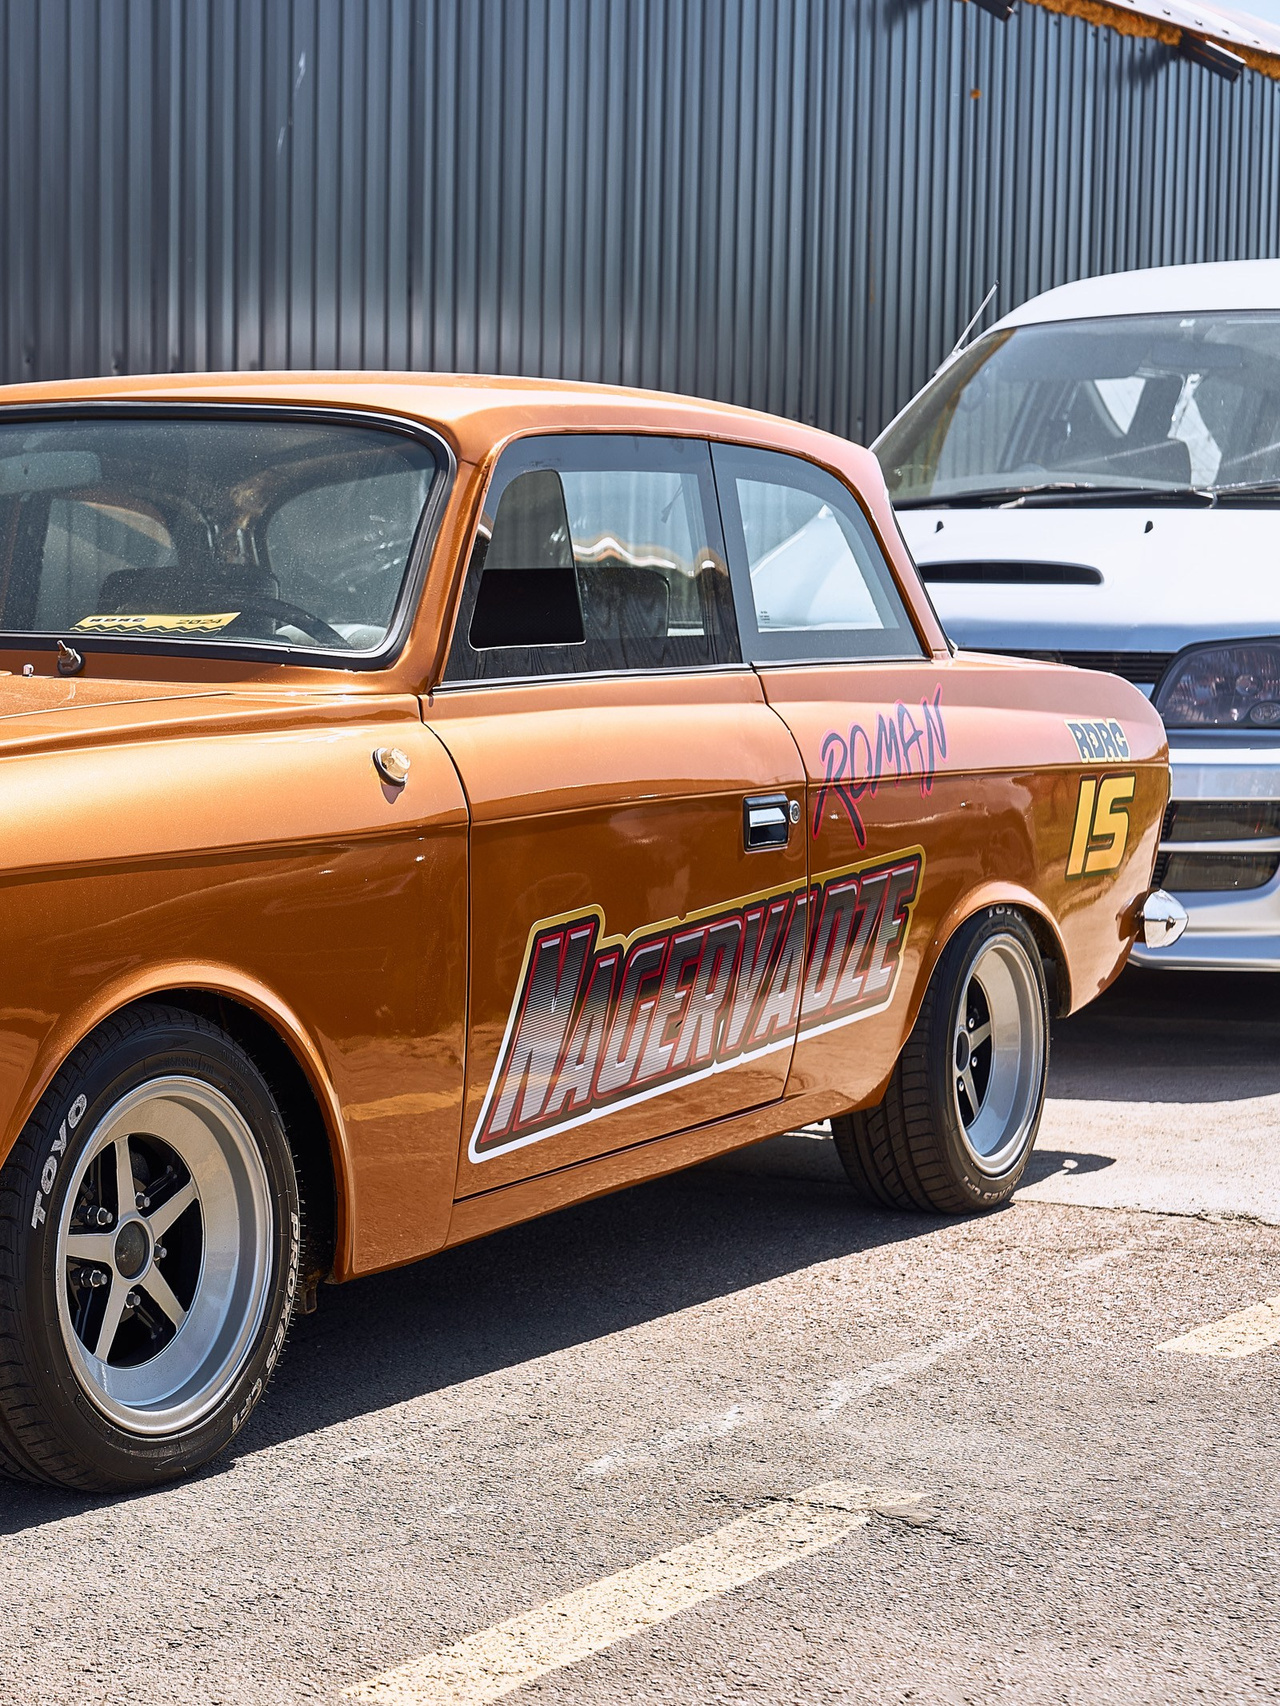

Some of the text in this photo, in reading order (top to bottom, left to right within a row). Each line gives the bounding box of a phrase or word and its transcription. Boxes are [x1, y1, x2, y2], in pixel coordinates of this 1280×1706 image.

[813, 683, 948, 849] ROMAN
[1065, 772, 1136, 881] 15
[483, 857, 923, 1143] NAGERVADZE
[30, 1092, 87, 1230] TOYO
[266, 1211, 300, 1374] PROXES
